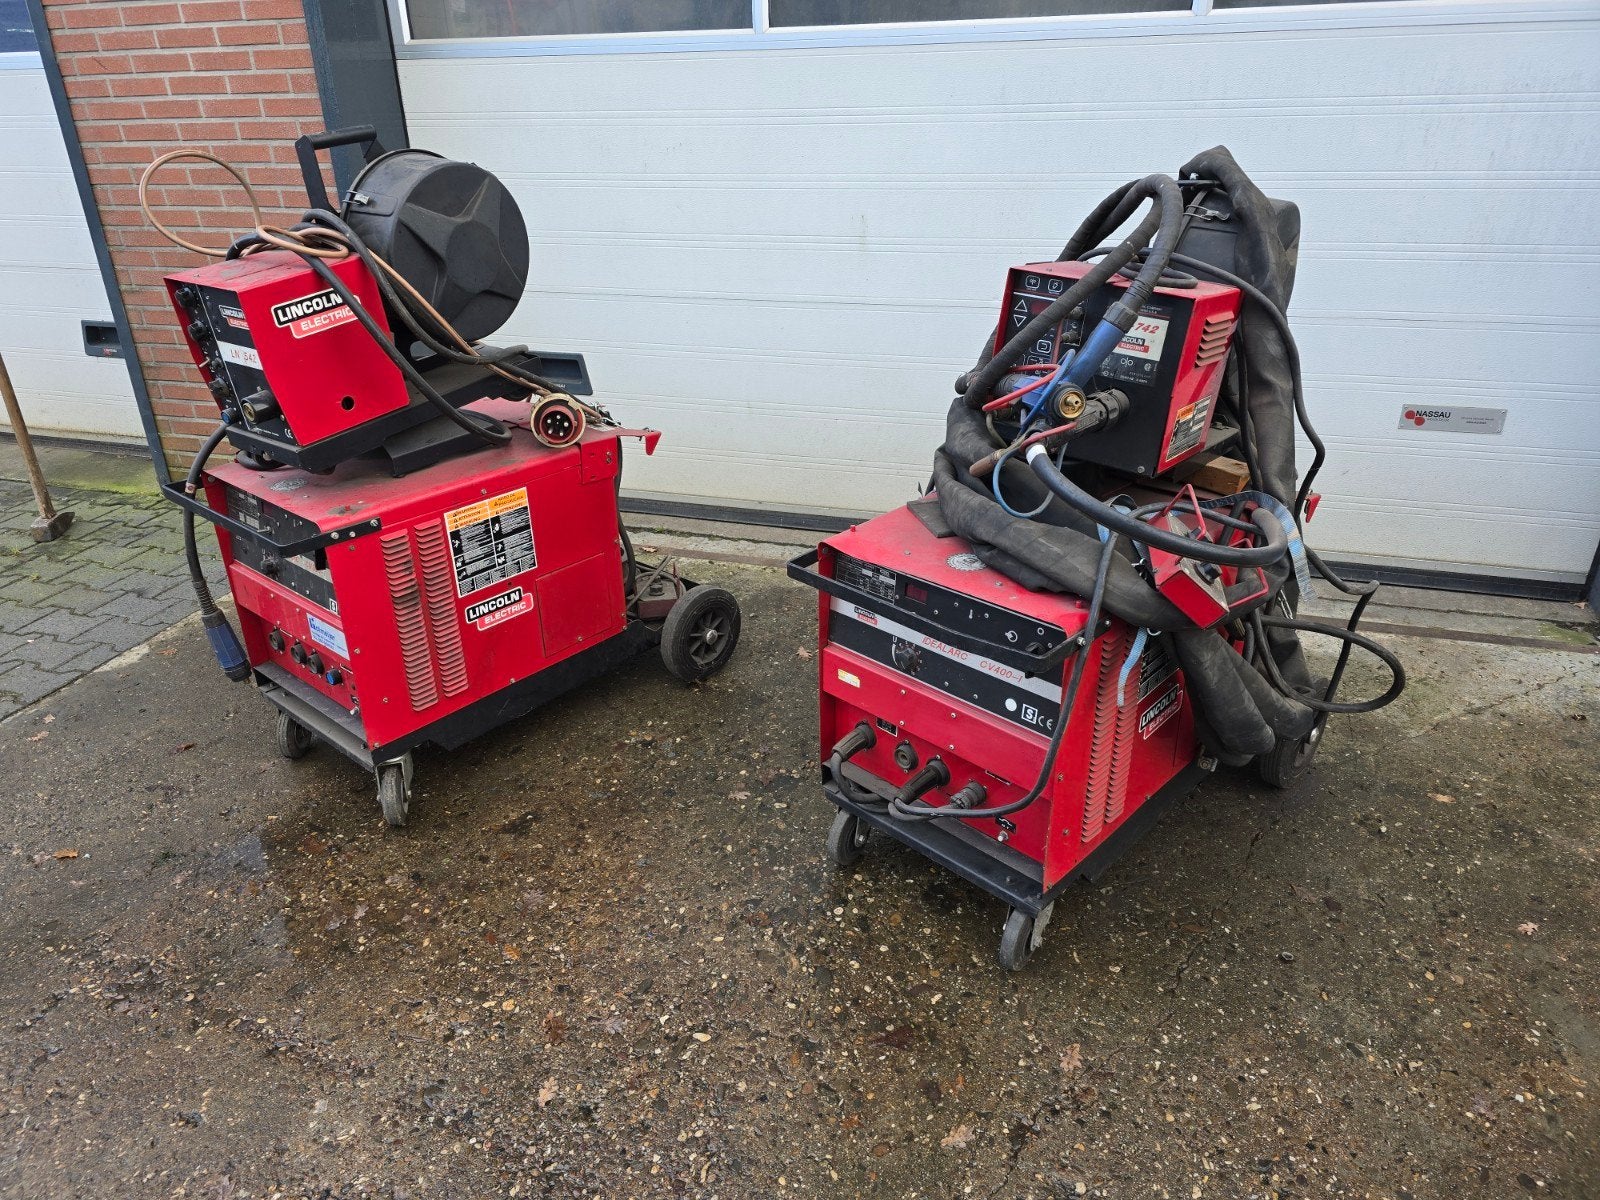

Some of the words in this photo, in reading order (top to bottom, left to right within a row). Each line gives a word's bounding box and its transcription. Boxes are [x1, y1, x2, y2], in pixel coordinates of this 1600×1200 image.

[277, 293, 344, 323] LINCOLN
[301, 306, 354, 331] ELECTRIC
[1134, 321, 1160, 335] 742
[1415, 410, 1451, 419] NASSAU
[468, 590, 520, 620] LINCOLN
[484, 601, 527, 625] ELECTRIC
[921, 635, 969, 661] IDEALARC
[1141, 689, 1177, 728] LINCOLN
